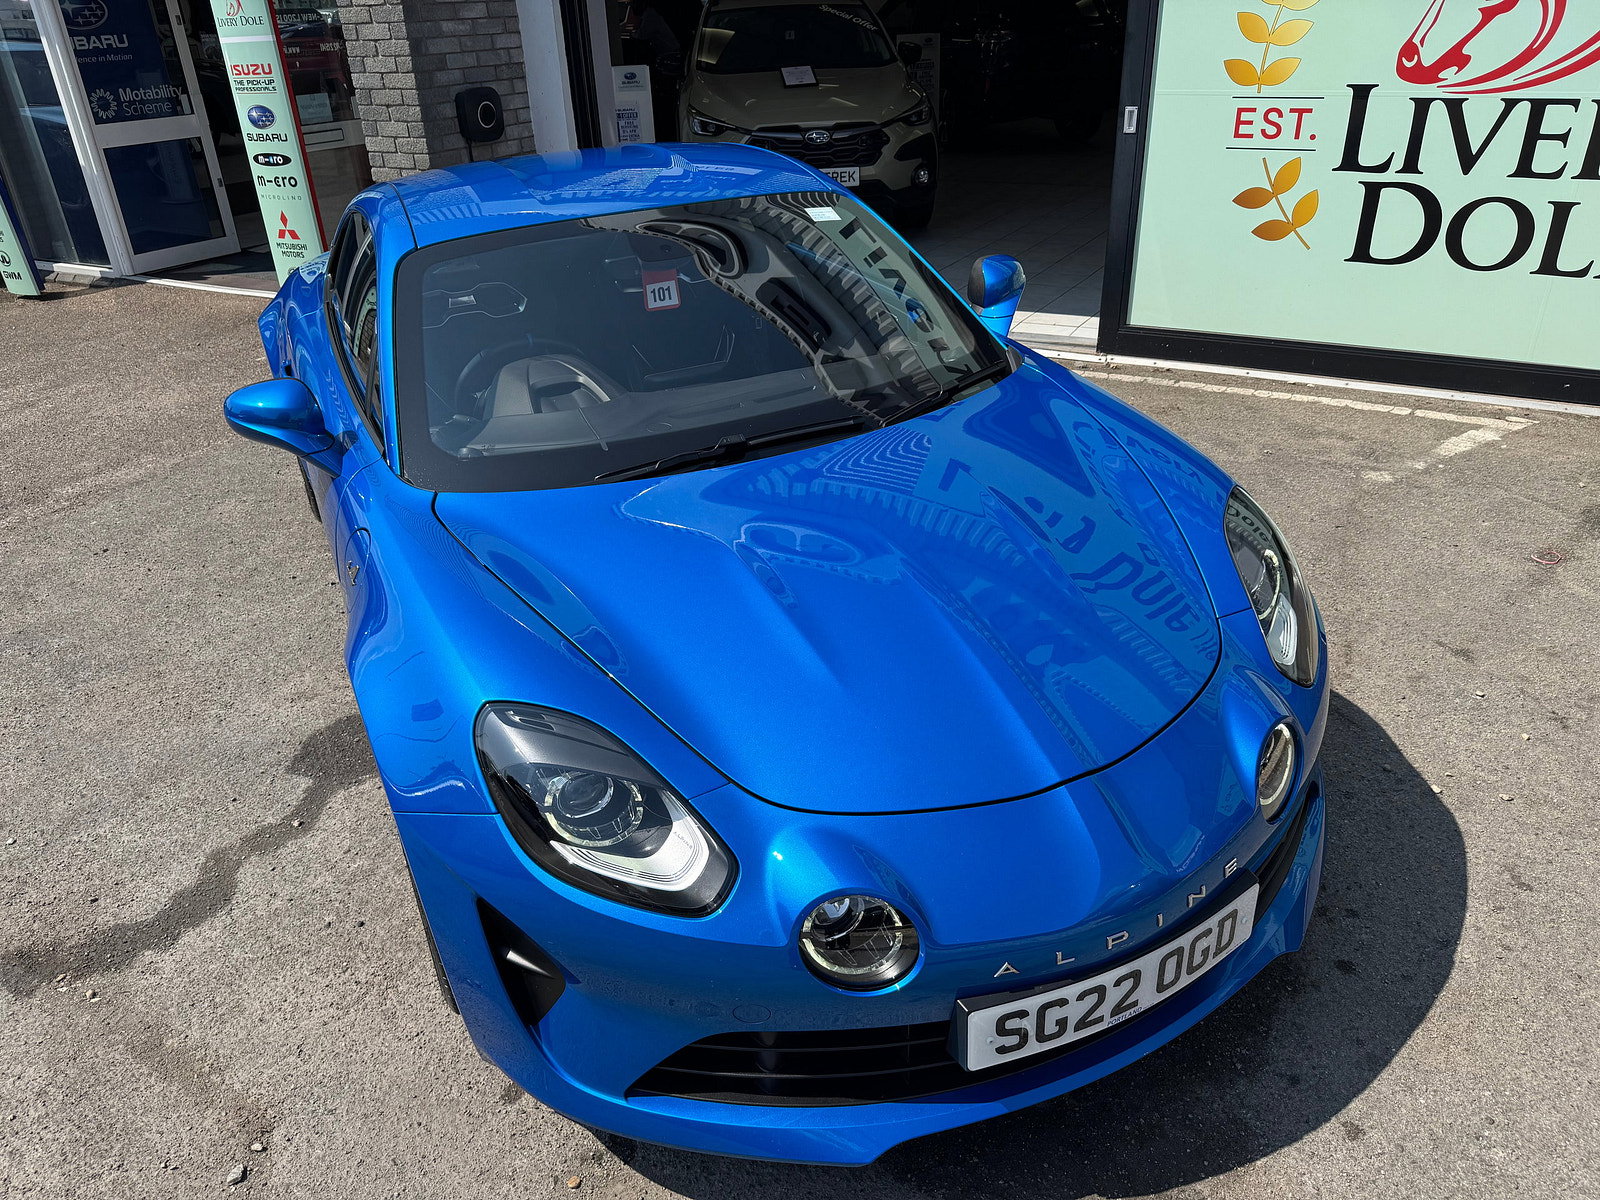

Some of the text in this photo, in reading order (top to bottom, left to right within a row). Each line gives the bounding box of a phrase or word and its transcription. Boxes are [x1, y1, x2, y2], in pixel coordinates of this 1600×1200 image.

[217, 15, 265, 28] LIVERY DOLE
[819, 4, 879, 31] Special Offer
[71, 33, 129, 50] BARU
[98, 54, 106, 62] in
[106, 53, 133, 62] Motion
[230, 63, 273, 77] ISUZU
[118, 84, 182, 102] Motability
[122, 101, 172, 116] Scheme
[1232, 106, 1317, 141] EST.
[1332, 83, 1600, 181] LIVE
[246, 132, 288, 142] SUBARU
[826, 170, 856, 183] REK
[1344, 180, 1600, 279] DOL
[276, 242, 308, 251] MITSUBISHI
[281, 250, 305, 259] MOTORS
[650, 285, 673, 303] 101
[993, 857, 1237, 978] ALPINE
[994, 907, 1239, 1056] SG22 OGD
[1106, 1006, 1143, 1027] PORTLAND
